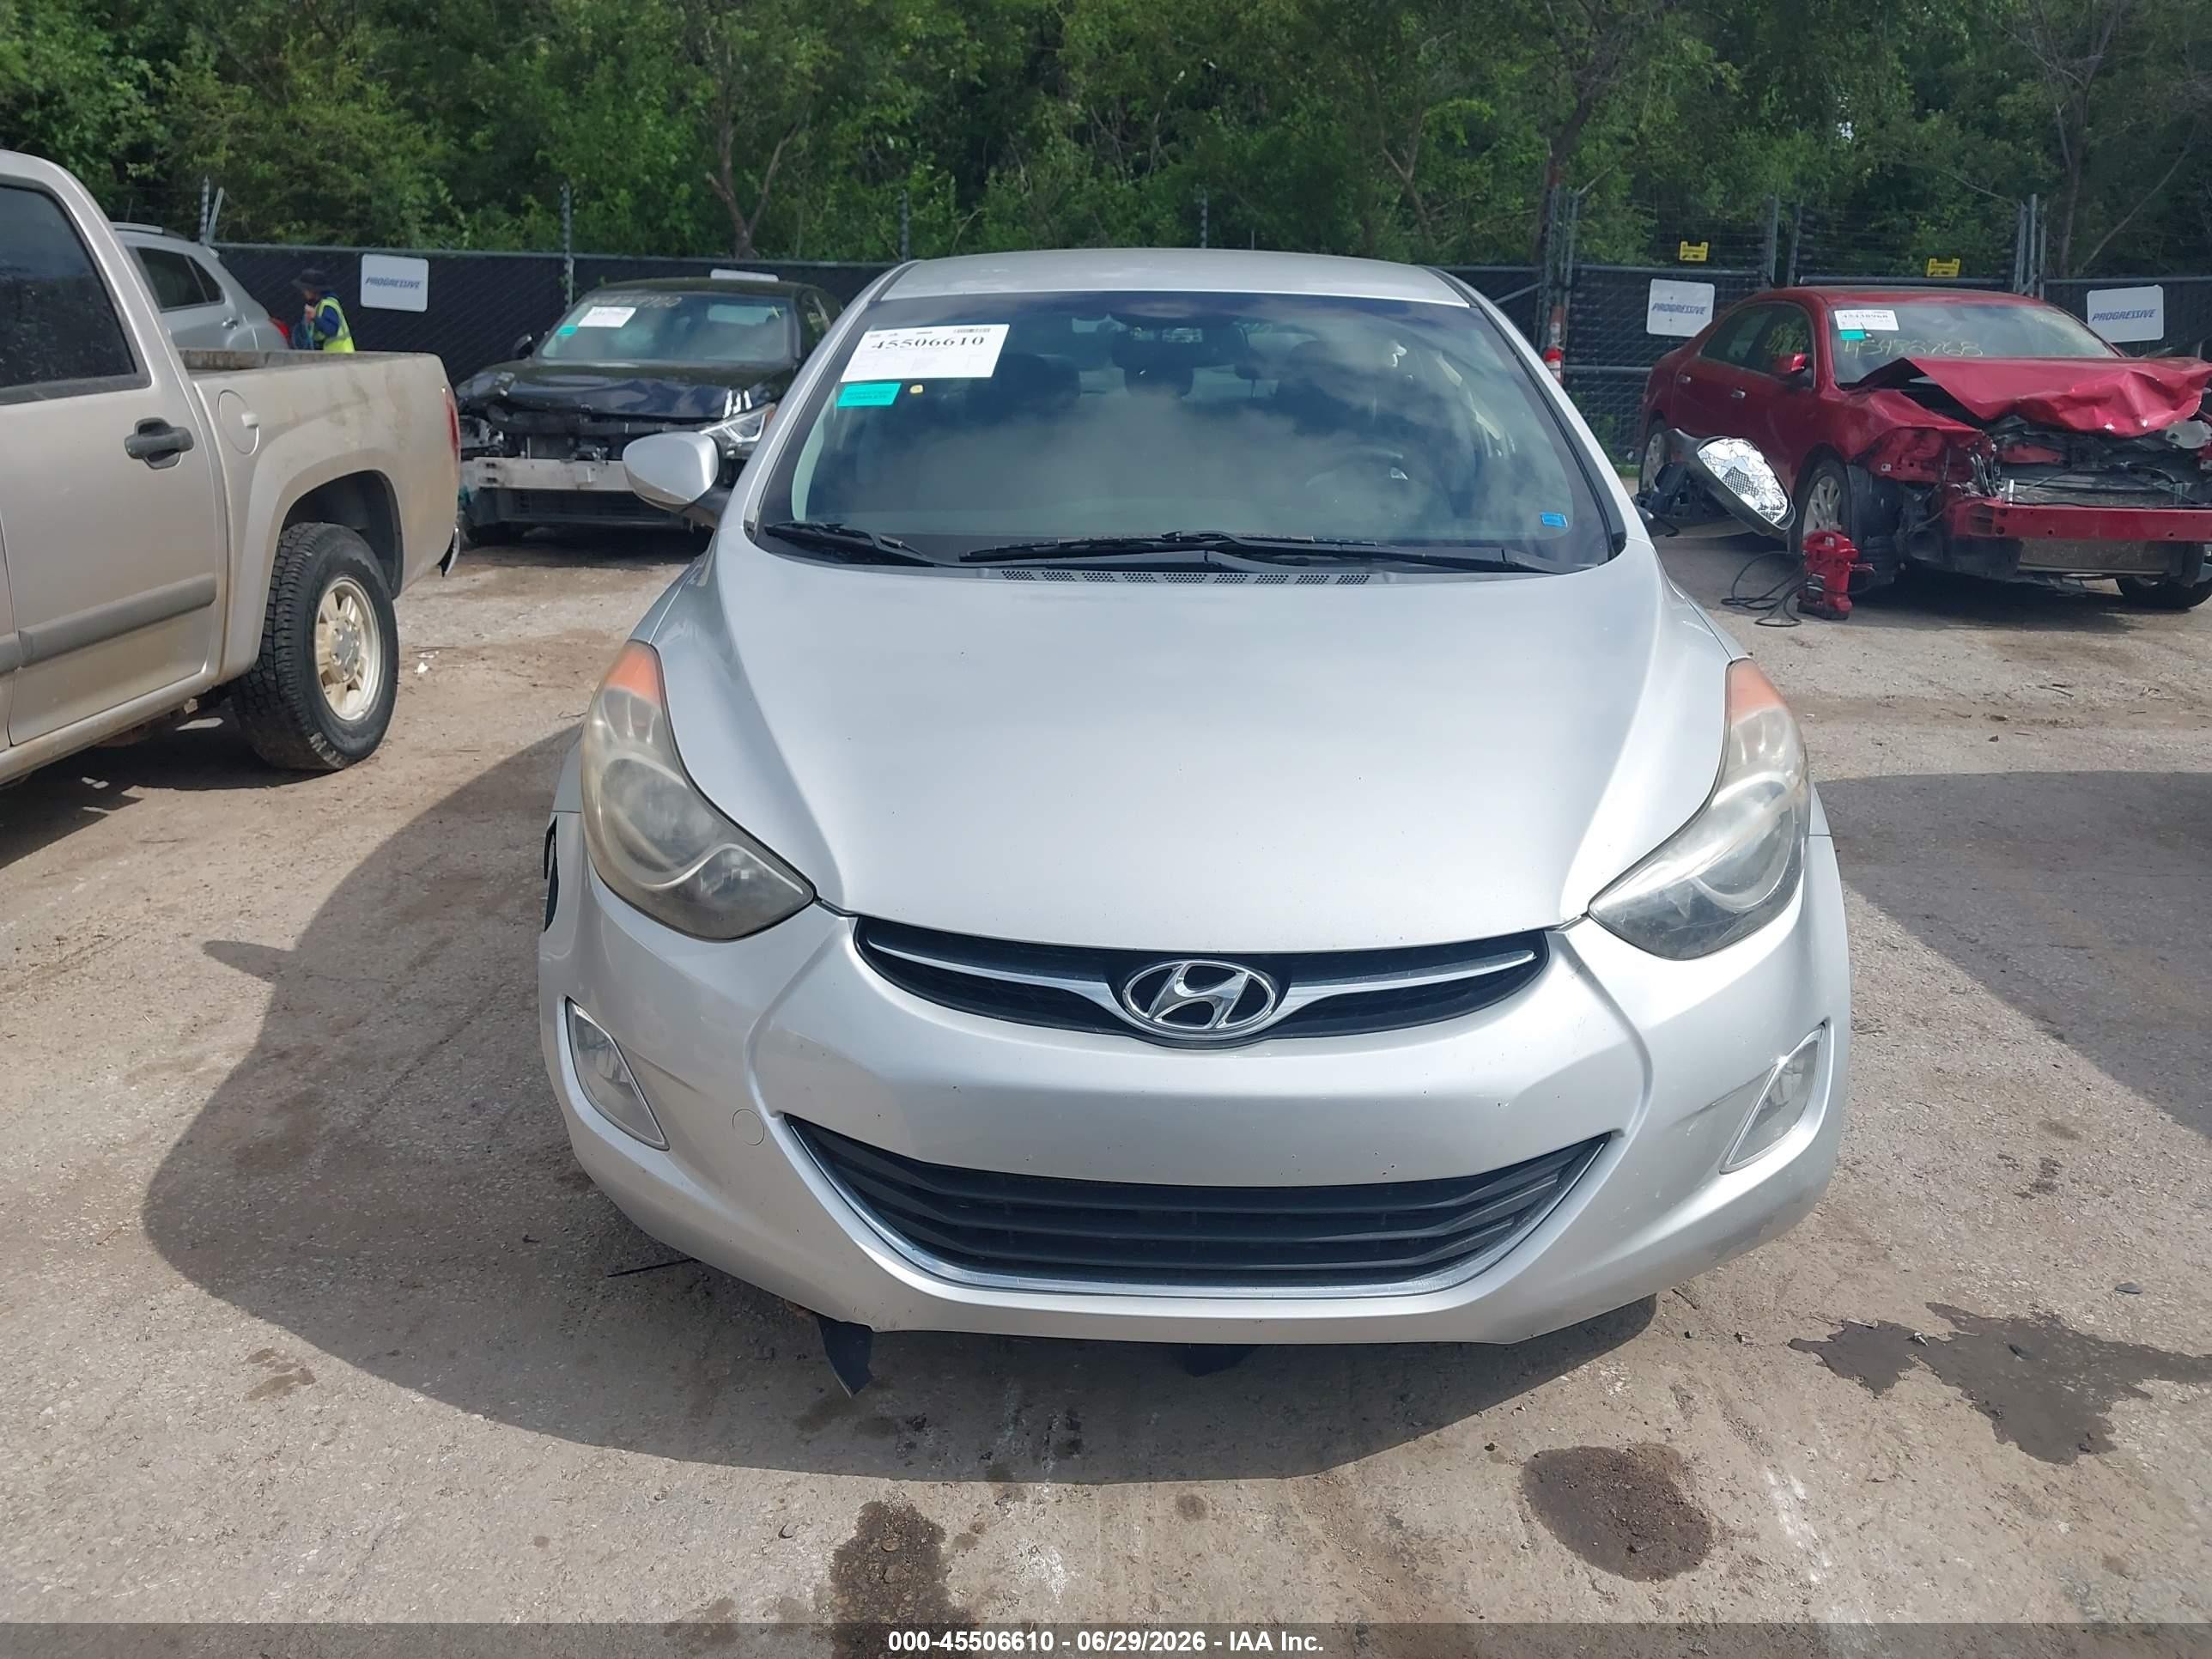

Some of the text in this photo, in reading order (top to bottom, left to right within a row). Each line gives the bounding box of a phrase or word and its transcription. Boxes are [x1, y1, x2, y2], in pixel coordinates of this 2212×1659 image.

[365, 276, 420, 289] PROGRESSIVE
[1651, 302, 1706, 315] PROGRESSIVE
[2092, 308, 2156, 322] PROGRESSIVE
[872, 336, 985, 350] 45506610
